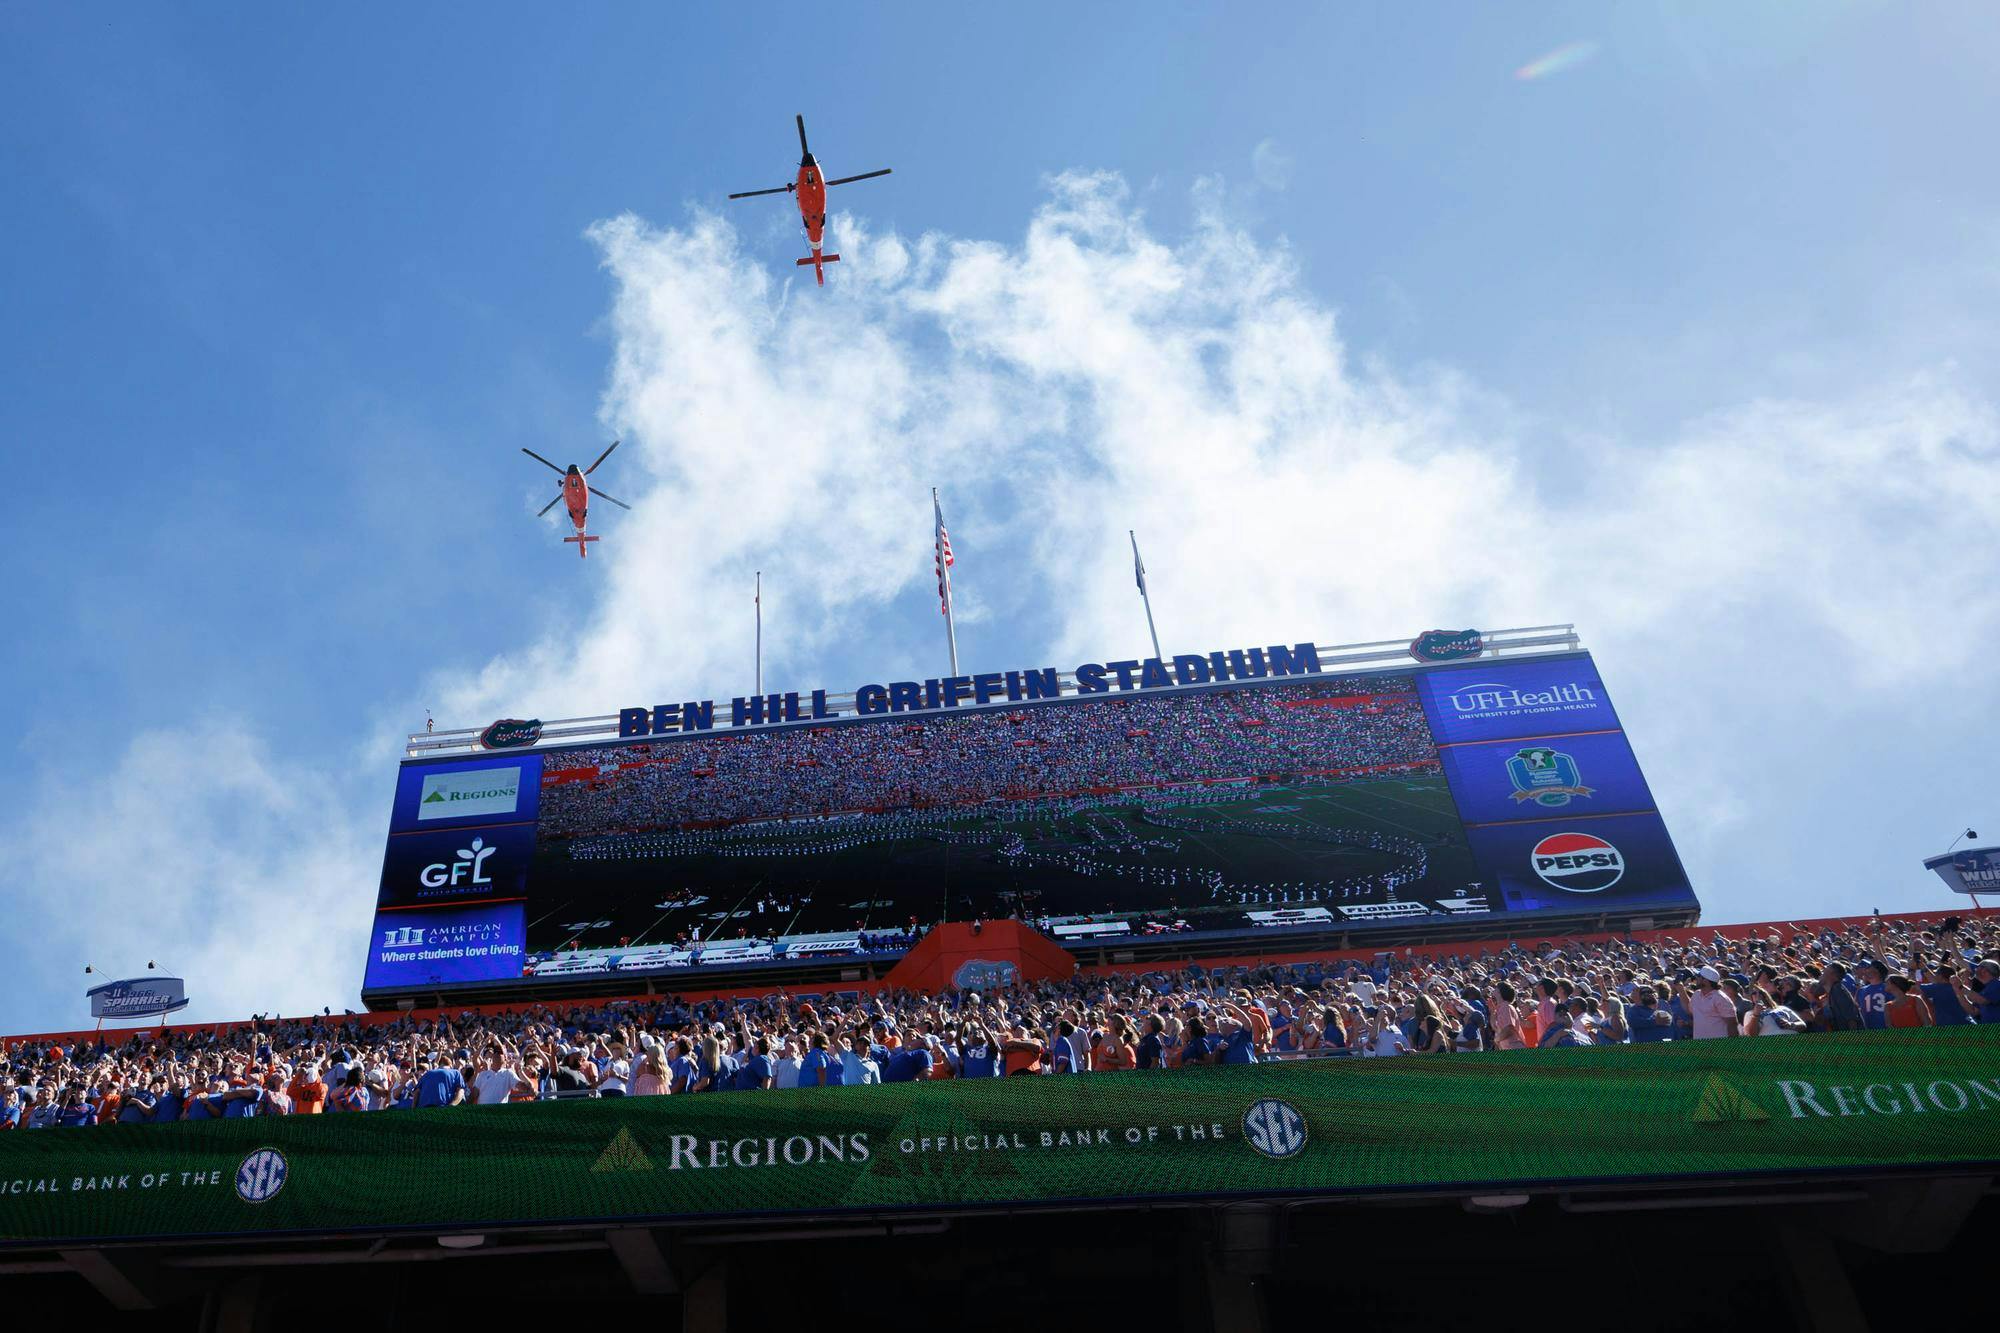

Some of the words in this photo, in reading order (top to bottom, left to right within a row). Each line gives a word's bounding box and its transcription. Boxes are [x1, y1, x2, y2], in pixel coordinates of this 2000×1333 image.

[619, 700, 714, 737] BEN
[732, 689, 839, 727] HILL
[856, 668, 1059, 715] GRIFFIN
[1075, 642, 1322, 695] STADIUM
[1458, 710, 1509, 720] UNIVERSITY
[1509, 708, 1521, 716] OF
[1523, 705, 1561, 714] FLORIDA
[1563, 703, 1598, 712] HEALTH
[449, 787, 516, 801] REGIONS
[420, 846, 497, 887] GFL
[1536, 852, 1619, 870] PEPSI
[1346, 902, 1422, 914] FLORIDA
[428, 932, 501, 944] CAMPUS
[430, 923, 501, 936] AMERICAN
[381, 949, 416, 963] Where
[417, 947, 464, 961] students
[465, 945, 488, 957] love
[490, 944, 522, 956] living.
[791, 941, 857, 951] FLORIDA
[103, 995, 170, 1007] SPURRIER
[1864, 992, 1886, 1012] 13
[900, 1132, 1026, 1154] OFFICIAL
[1040, 1129, 1112, 1148] BANK
[1125, 1125, 1160, 1144] OF
[1173, 1123, 1225, 1141] THE
[1245, 1101, 1303, 1156] SEC
[668, 1132, 870, 1170] REGIONS
[1, 1179, 60, 1194] ICIAL
[71, 1175, 130, 1192] BANK
[140, 1173, 170, 1189] OF
[180, 1170, 222, 1186] THE
[238, 1149, 287, 1200] SEC
